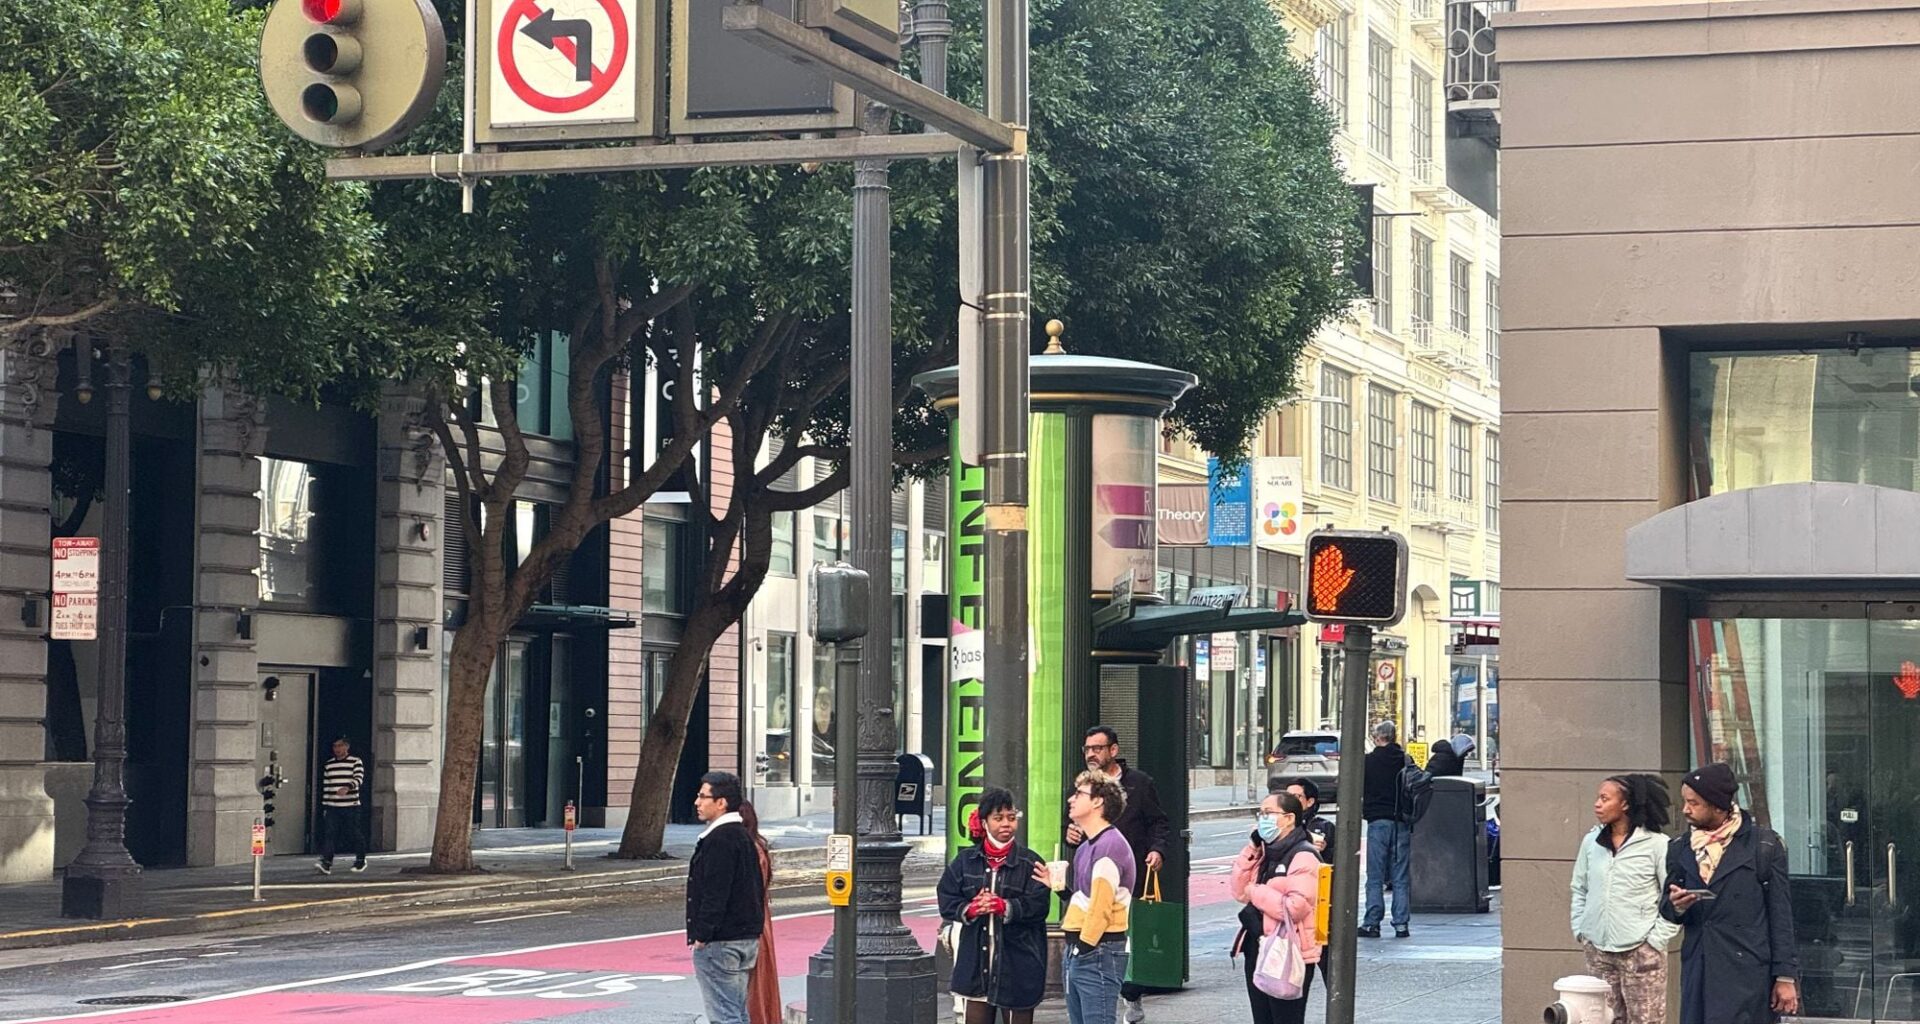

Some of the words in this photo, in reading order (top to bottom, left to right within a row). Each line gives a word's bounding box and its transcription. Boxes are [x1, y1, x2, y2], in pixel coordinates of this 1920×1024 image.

[1158, 508, 1206, 522] Theory
[54, 548, 67, 558] NO
[68, 549, 97, 557] STOPPING
[54, 594, 66, 606] NO
[68, 597, 97, 606] PARKING
[961, 649, 984, 664] bas
[368, 968, 687, 999] BUS
